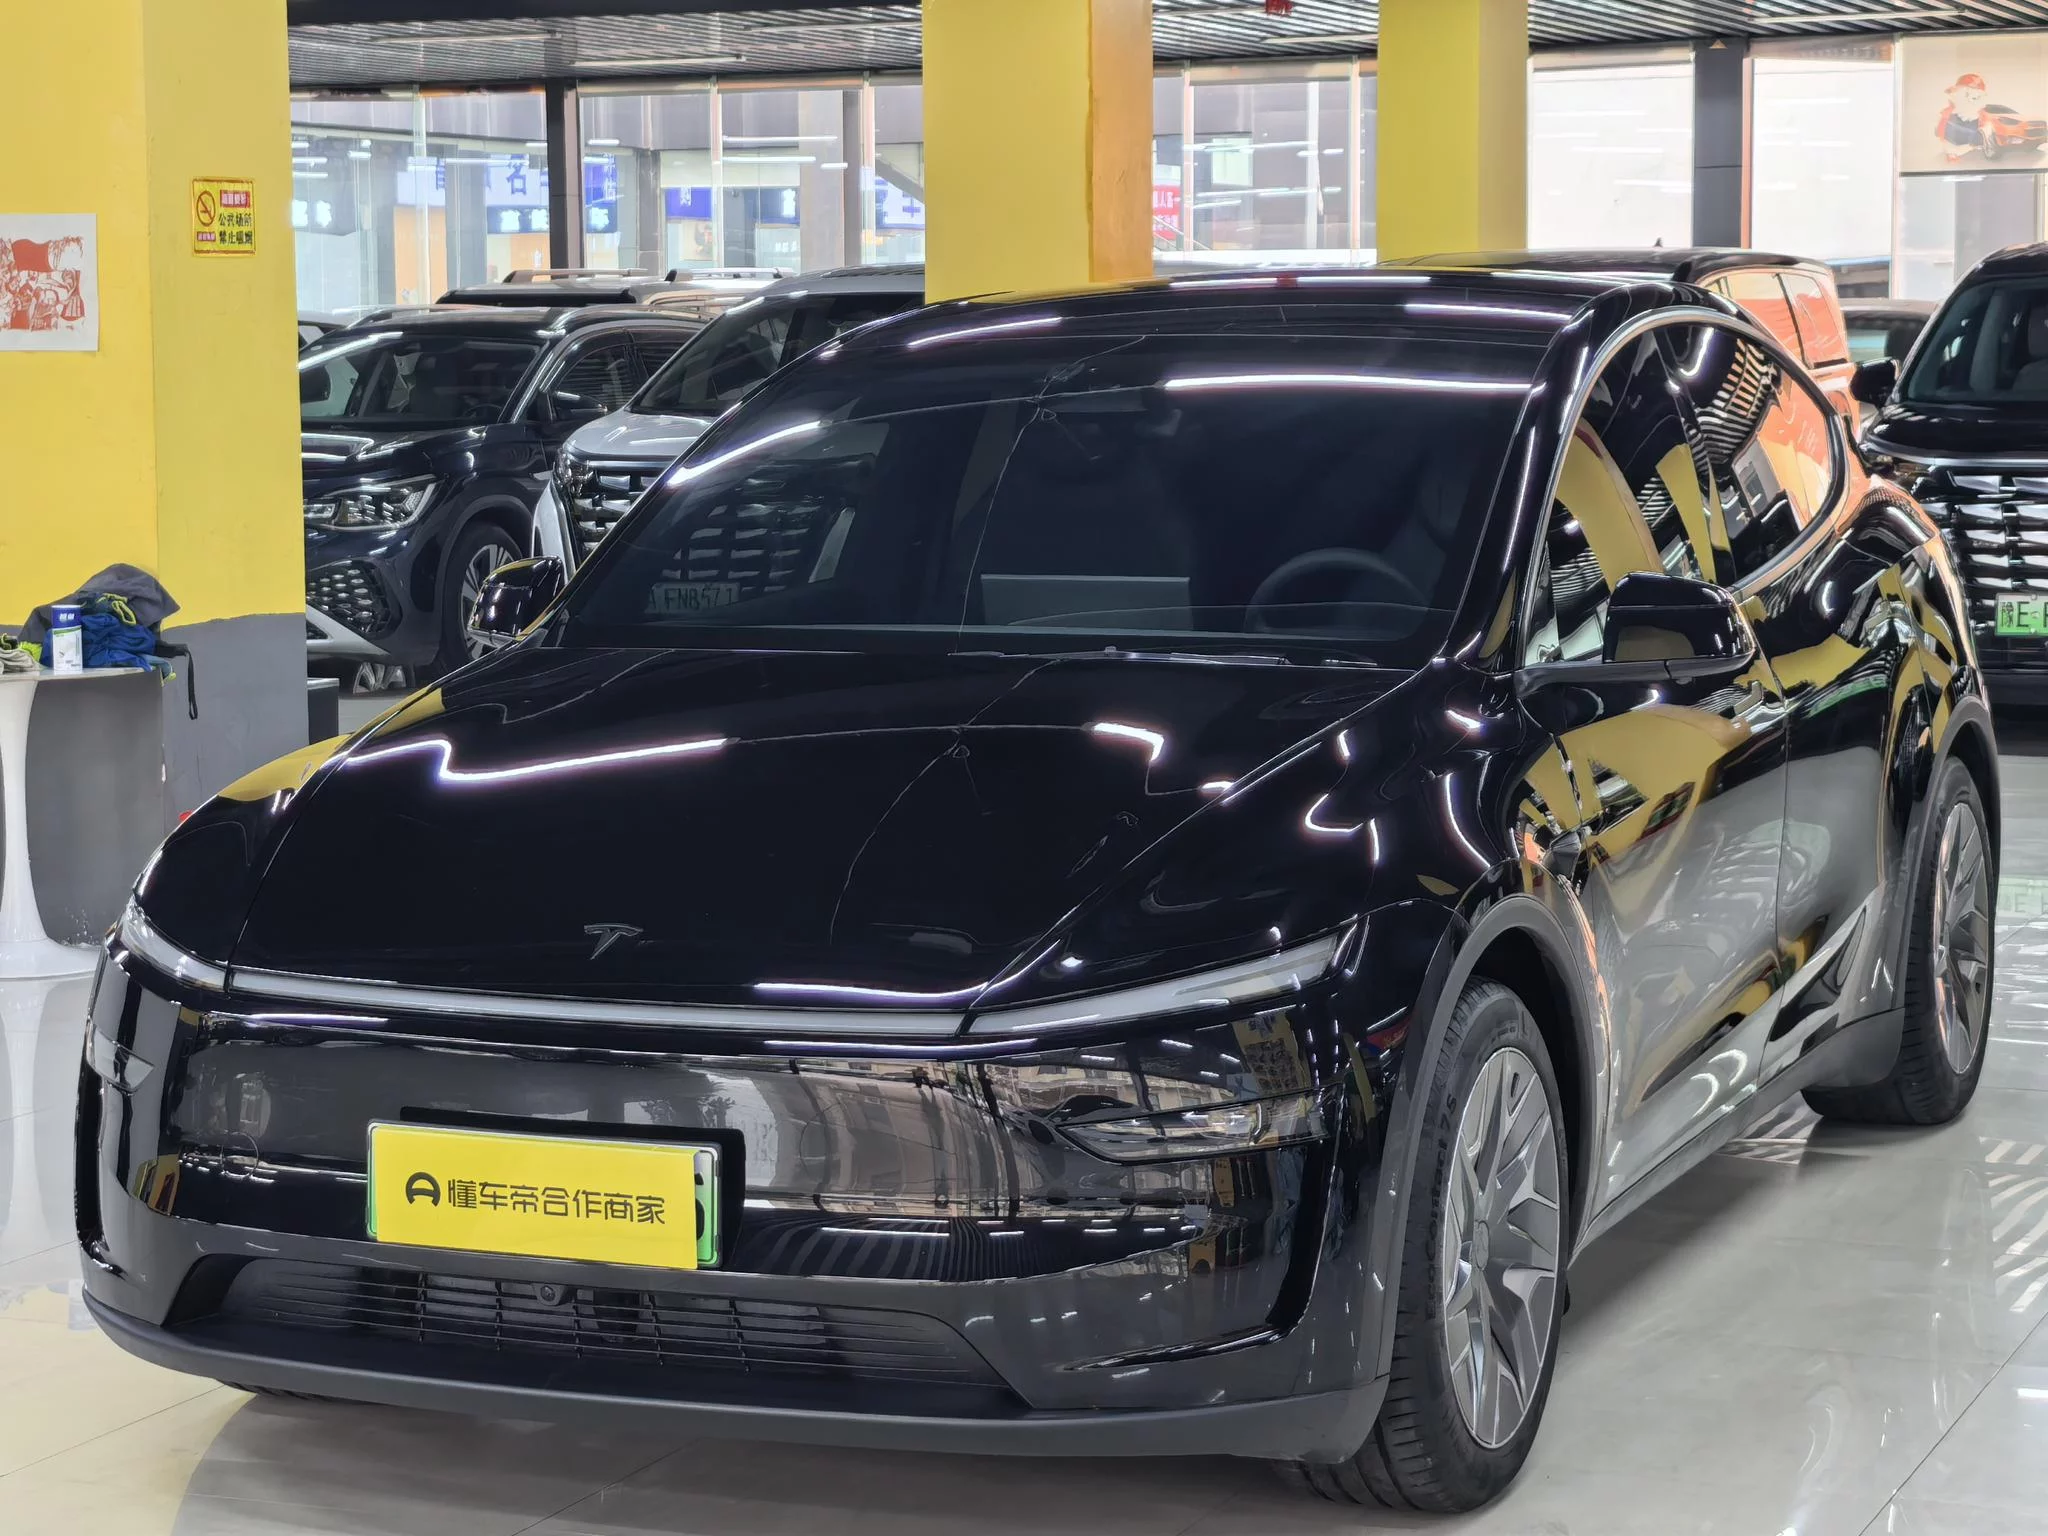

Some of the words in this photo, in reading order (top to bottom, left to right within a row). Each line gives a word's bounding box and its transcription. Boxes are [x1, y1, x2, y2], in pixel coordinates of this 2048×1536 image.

[448, 1179, 665, 1224] 懂车帝合作商家
